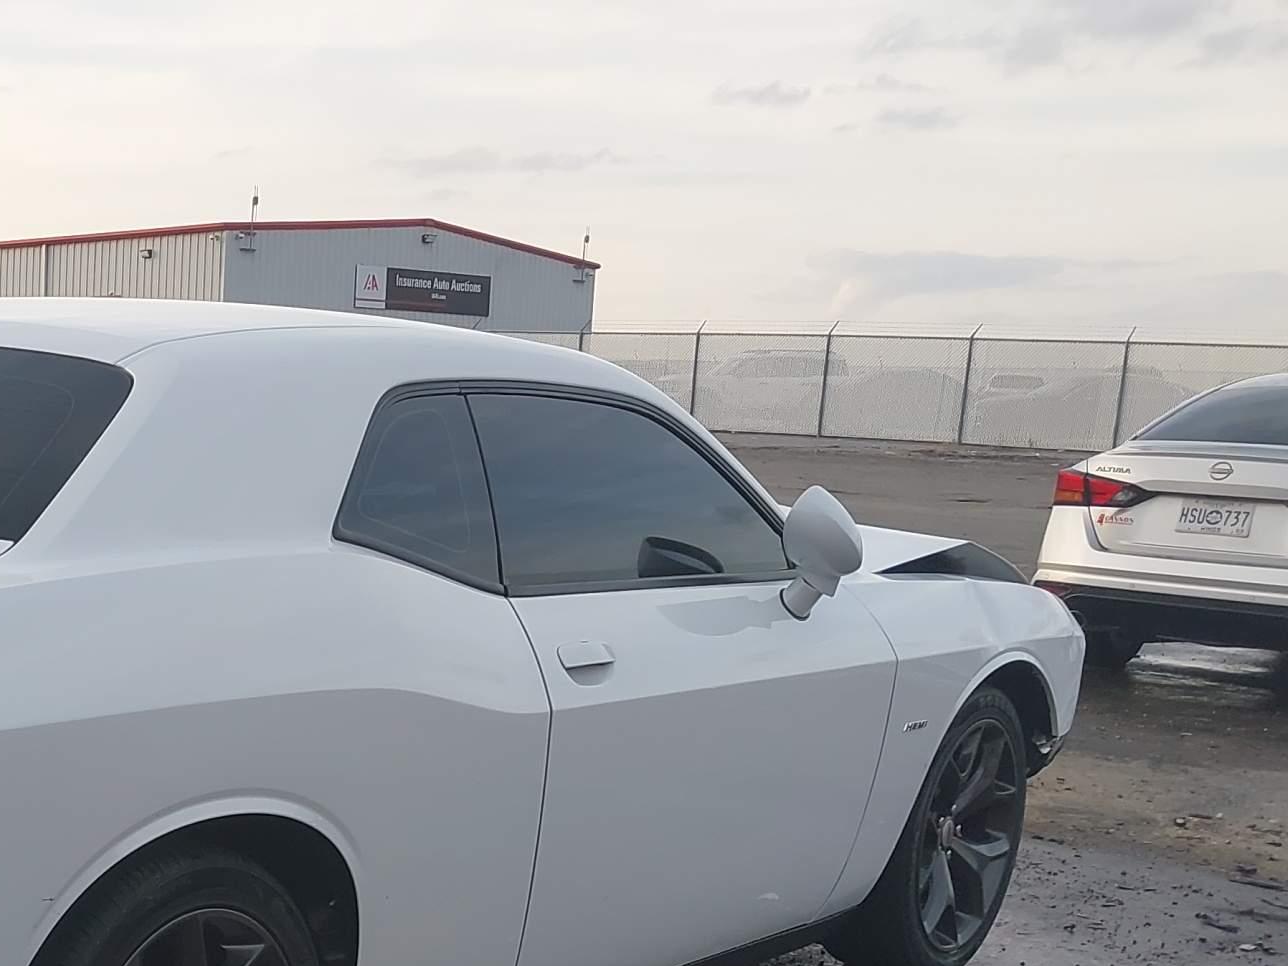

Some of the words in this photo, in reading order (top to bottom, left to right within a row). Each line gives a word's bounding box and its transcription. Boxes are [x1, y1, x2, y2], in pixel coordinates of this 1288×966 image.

[396, 273, 432, 289] Insurance
[433, 277, 450, 290] Auto
[451, 279, 482, 293] Auctions
[1096, 466, 1131, 474] ALTIMA
[1179, 507, 1207, 524] HSU
[1223, 510, 1250, 527] 737
[903, 719, 928, 732] HEMI
